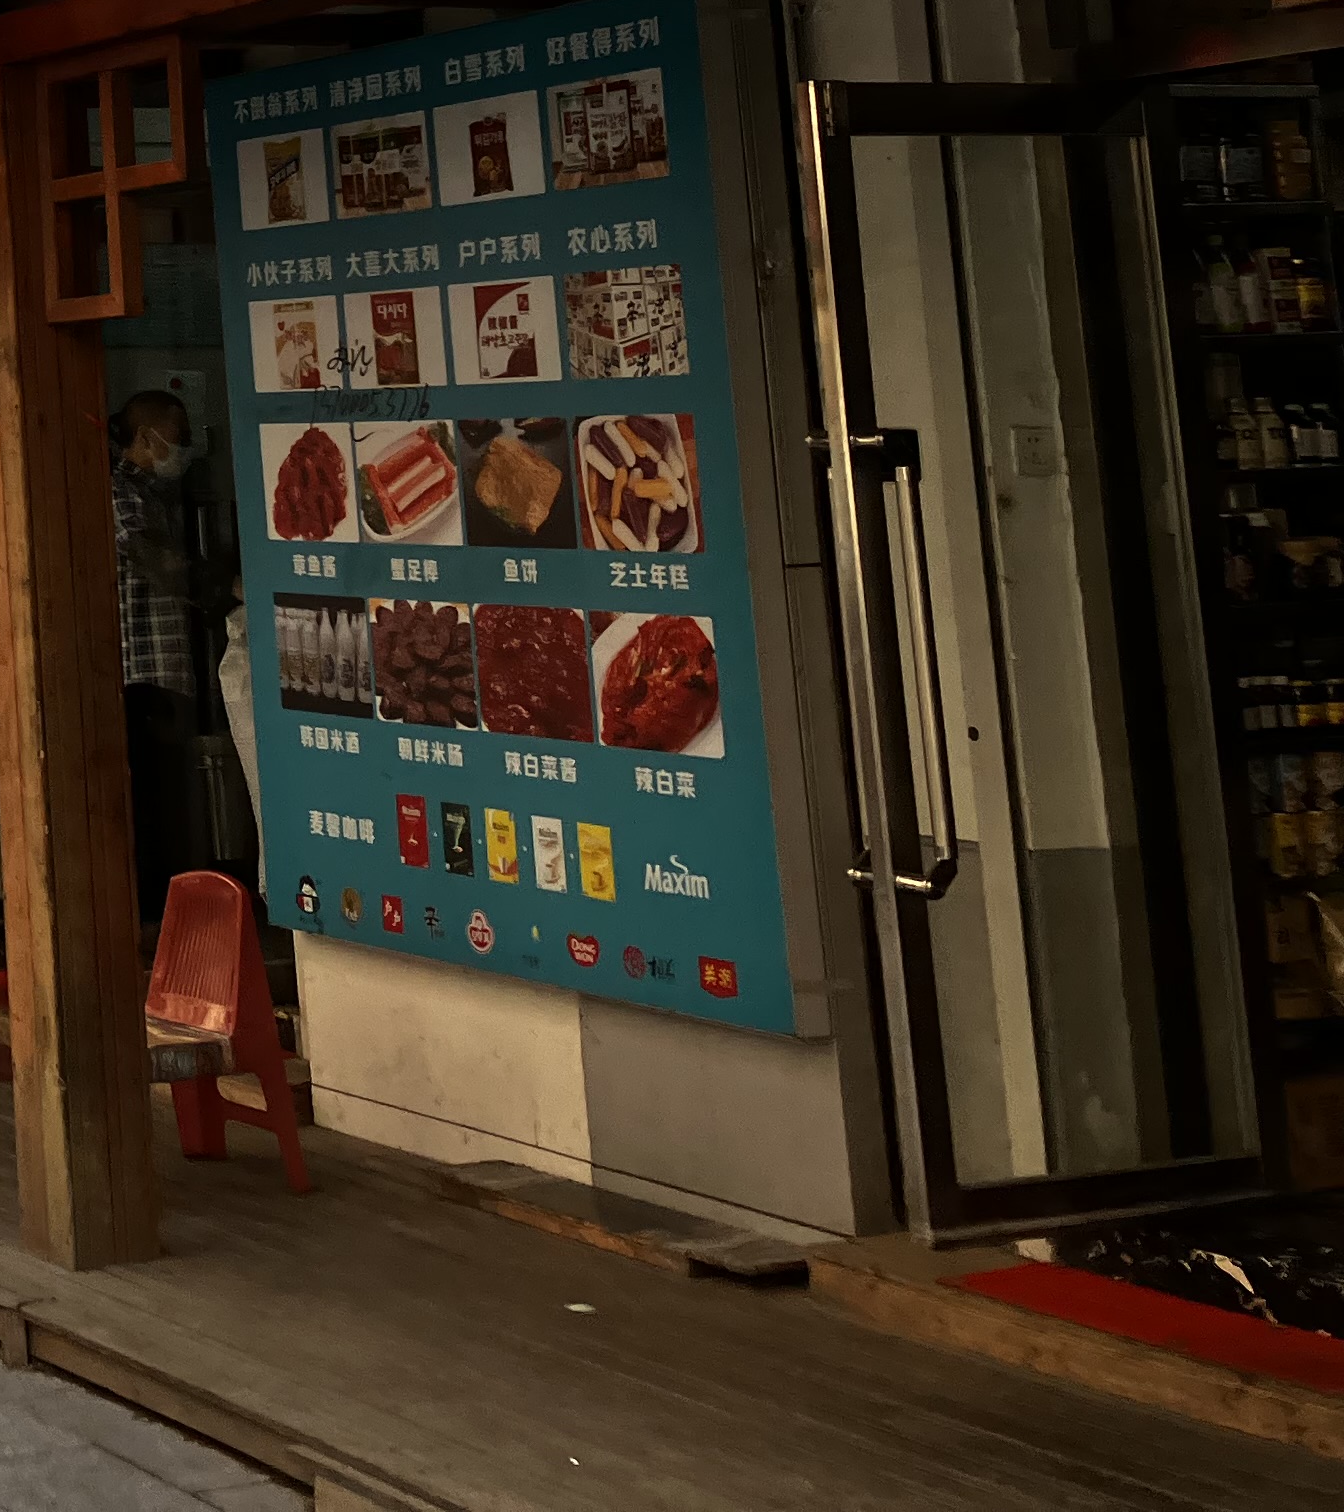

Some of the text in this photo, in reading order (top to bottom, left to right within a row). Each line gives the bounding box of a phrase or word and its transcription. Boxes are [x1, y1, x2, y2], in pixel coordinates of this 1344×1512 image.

[444, 44, 525, 87] 白雪系列
[459, 231, 541, 268] 户户系列
[568, 218, 657, 256] 农心系列
[246, 255, 332, 287] 小伙子系列
[346, 244, 439, 279] 大喜大系列
[503, 558, 538, 584] 鱼饼
[610, 561, 690, 590] 芝士年糕
[300, 725, 361, 754] 韩国米酒
[398, 737, 464, 767] 朝鲜米肠
[505, 751, 577, 784] 辣白菜酱
[635, 766, 696, 799] 辣白菜
[309, 809, 376, 845] 麦馨咖啡
[644, 862, 709, 900] Maxim
